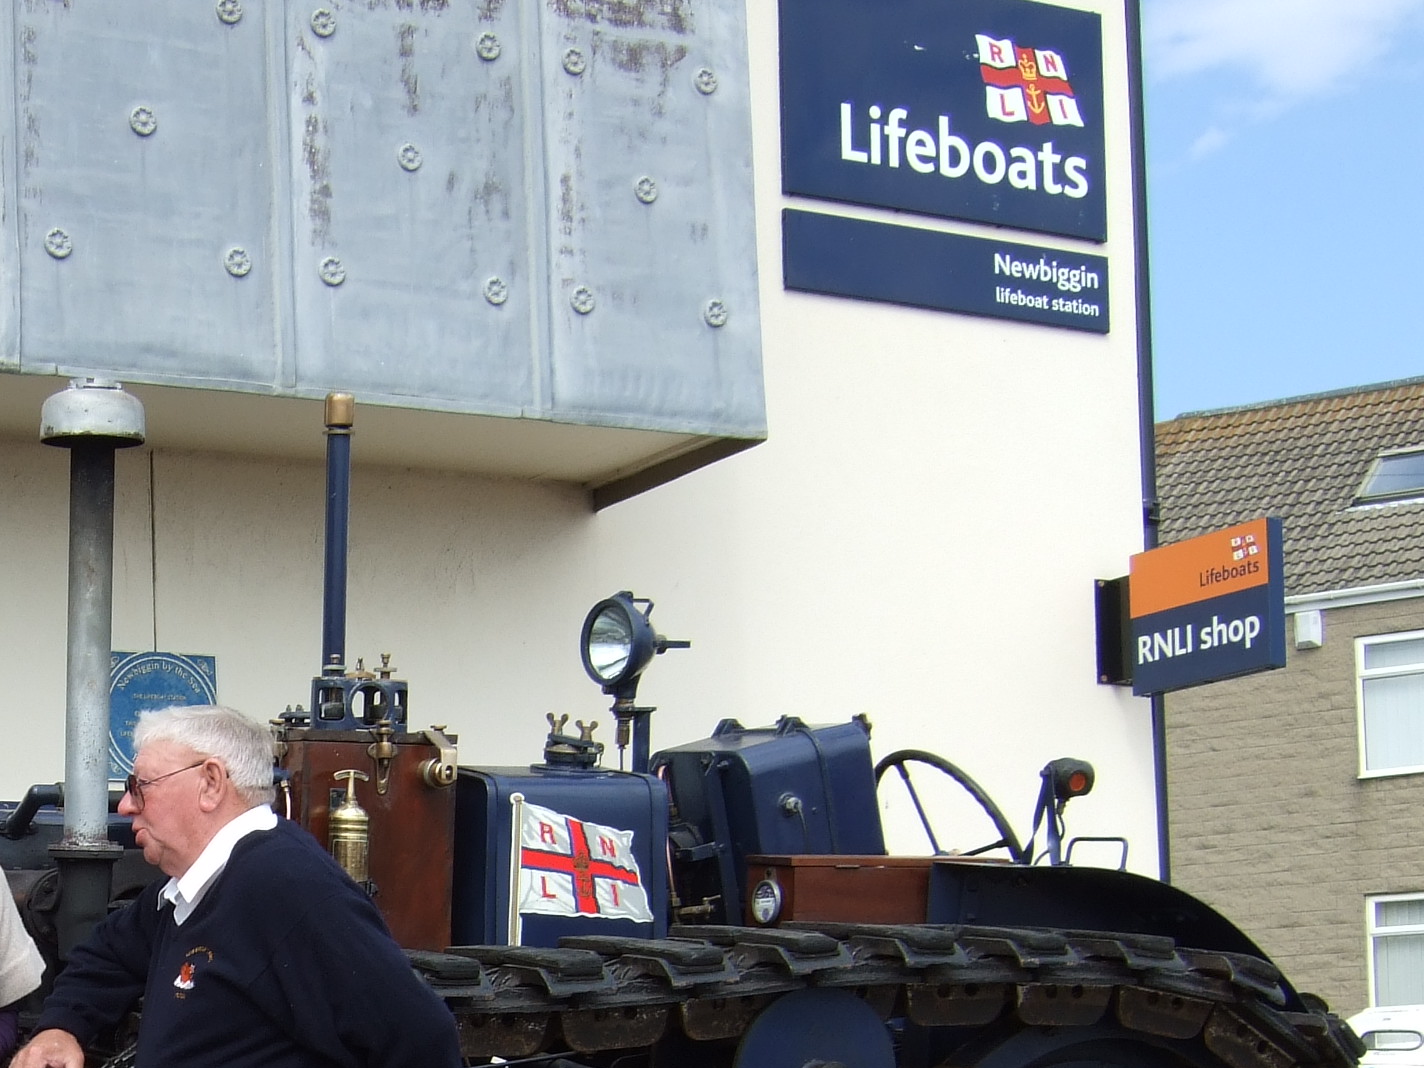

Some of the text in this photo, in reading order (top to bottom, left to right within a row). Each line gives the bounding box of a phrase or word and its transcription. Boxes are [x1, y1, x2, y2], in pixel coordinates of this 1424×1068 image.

[989, 42, 1058, 73] R N
[1000, 94, 1069, 120] L I
[840, 102, 1089, 199] Lifeboats
[993, 253, 1099, 292] Newbiggin
[995, 286, 1100, 317] lifeboat station
[1199, 560, 1260, 588] Lifeboats
[1138, 614, 1261, 665] RNLI shop
[116, 661, 201, 694] Newbiggin by the Sea
[539, 821, 618, 859] R N
[541, 876, 620, 907] L I
